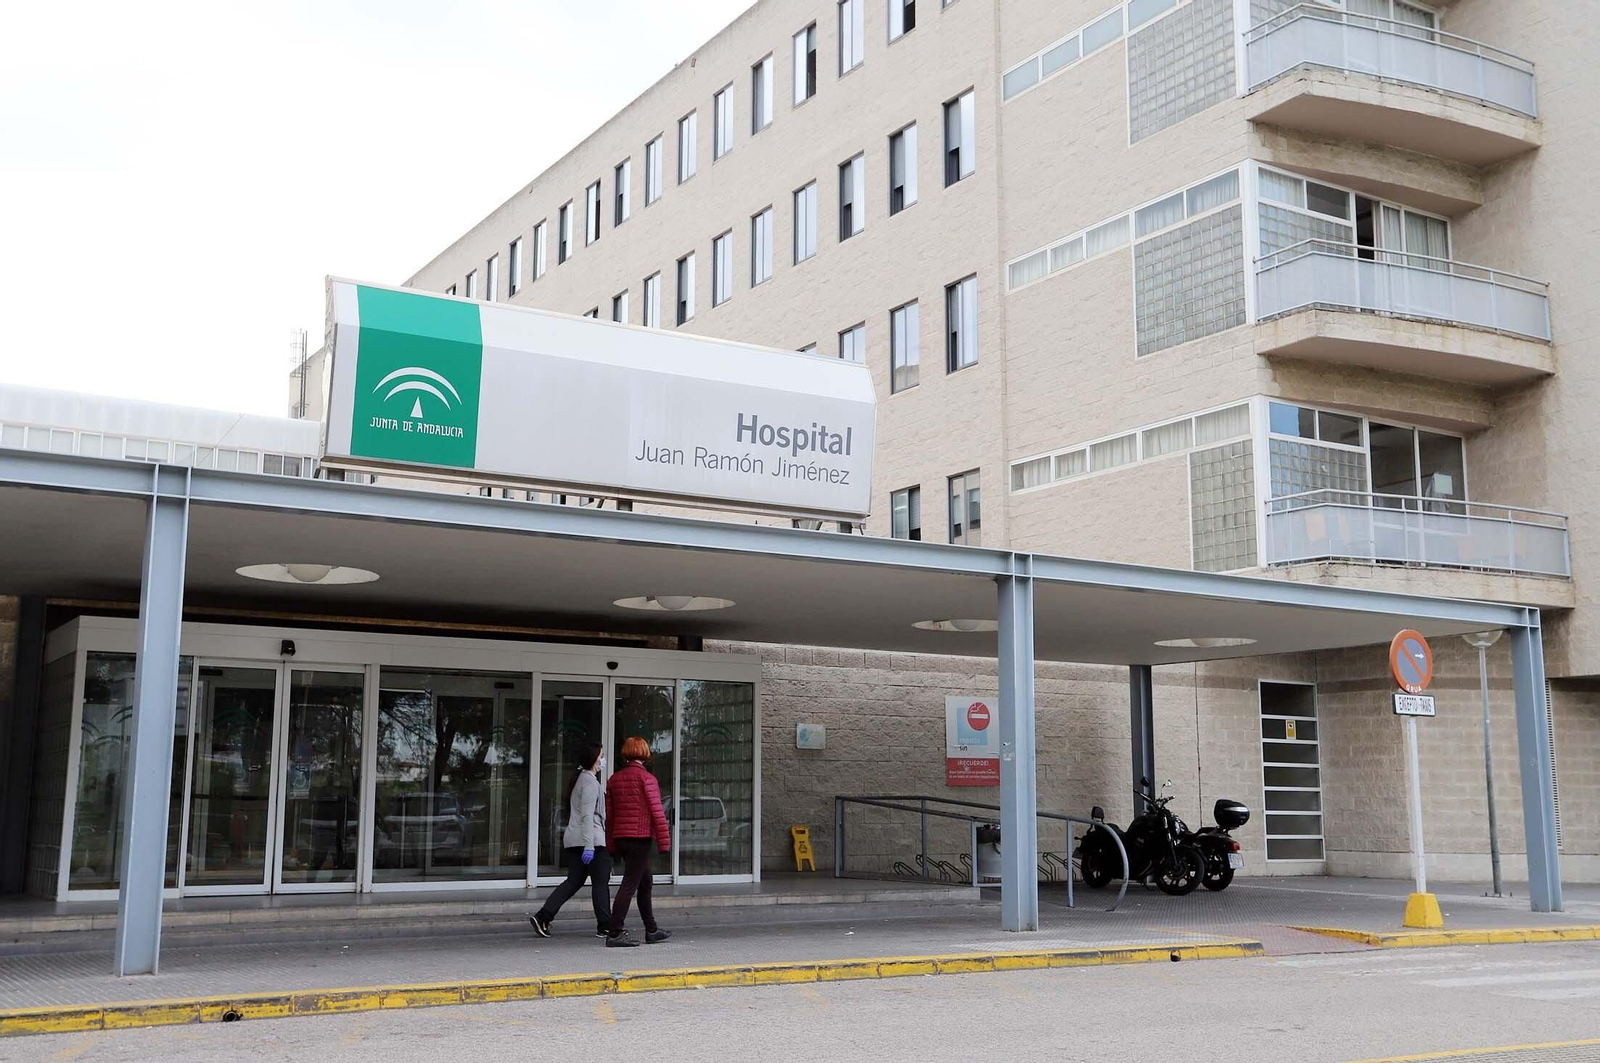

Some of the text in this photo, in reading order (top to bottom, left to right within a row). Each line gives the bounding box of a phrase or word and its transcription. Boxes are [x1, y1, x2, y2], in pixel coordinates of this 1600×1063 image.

[370, 417, 398, 430] JUNTA
[402, 420, 414, 432] DE
[736, 412, 852, 457] Hospital
[635, 439, 850, 485] Juan Ramón Jiménez
